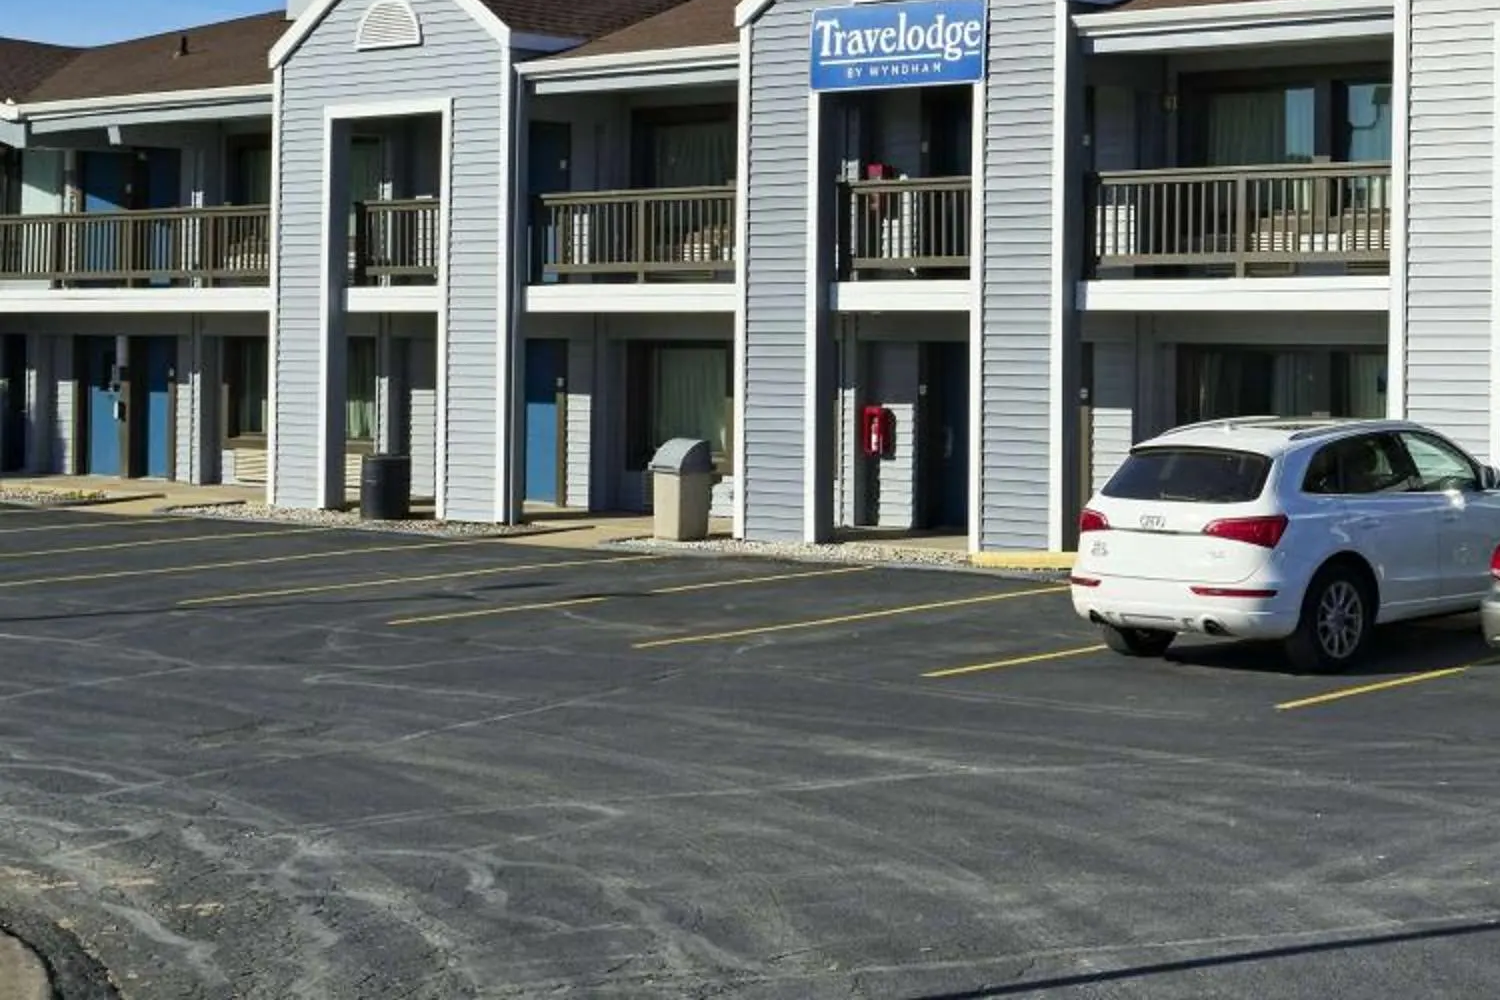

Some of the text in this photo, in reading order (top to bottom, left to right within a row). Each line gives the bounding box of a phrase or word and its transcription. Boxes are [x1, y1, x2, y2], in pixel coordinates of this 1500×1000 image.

[815, 11, 981, 61] Travelodge
[847, 62, 942, 79] BY WYNDHAM
